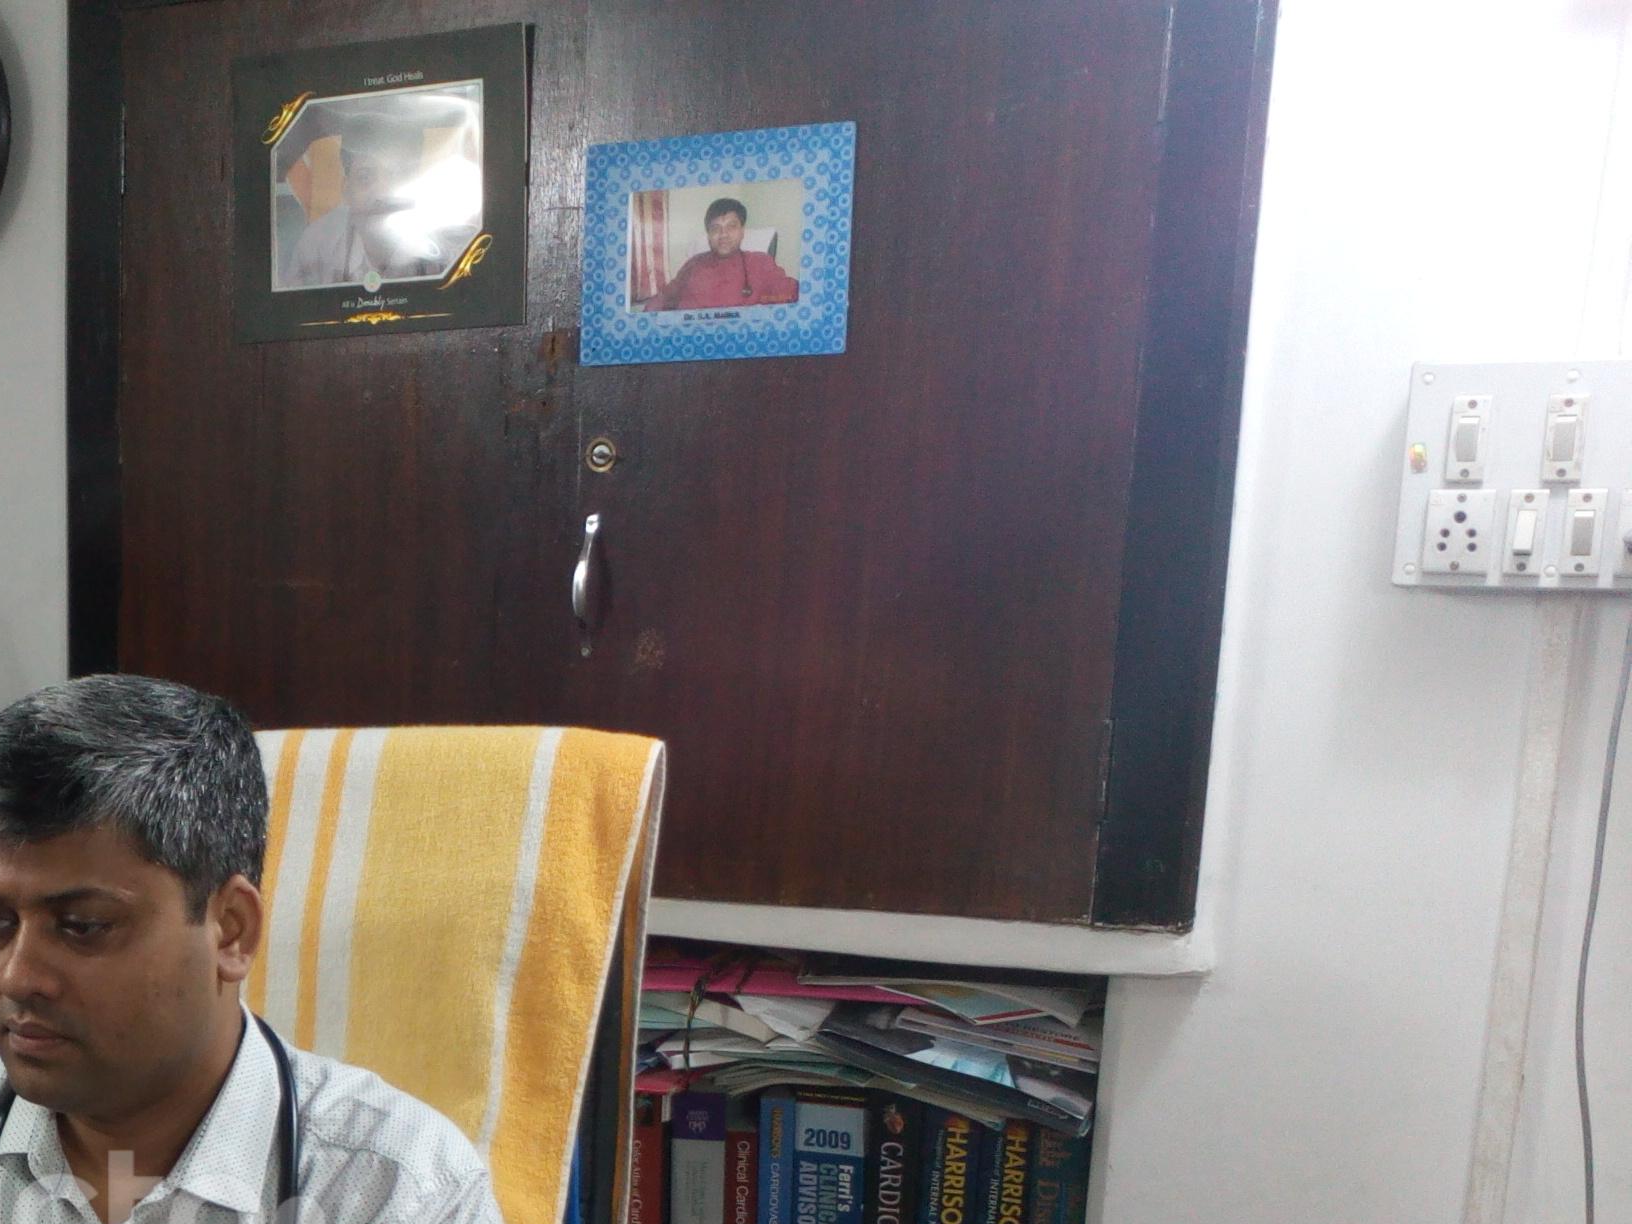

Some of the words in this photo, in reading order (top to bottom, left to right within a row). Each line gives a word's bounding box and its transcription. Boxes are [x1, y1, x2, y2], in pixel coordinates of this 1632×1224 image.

[803, 1127, 852, 1150] 2009
[736, 1140, 751, 1184] Clinical
[837, 1164, 854, 1213] Ferri's
[927, 1170, 941, 1219] INTERNAL
